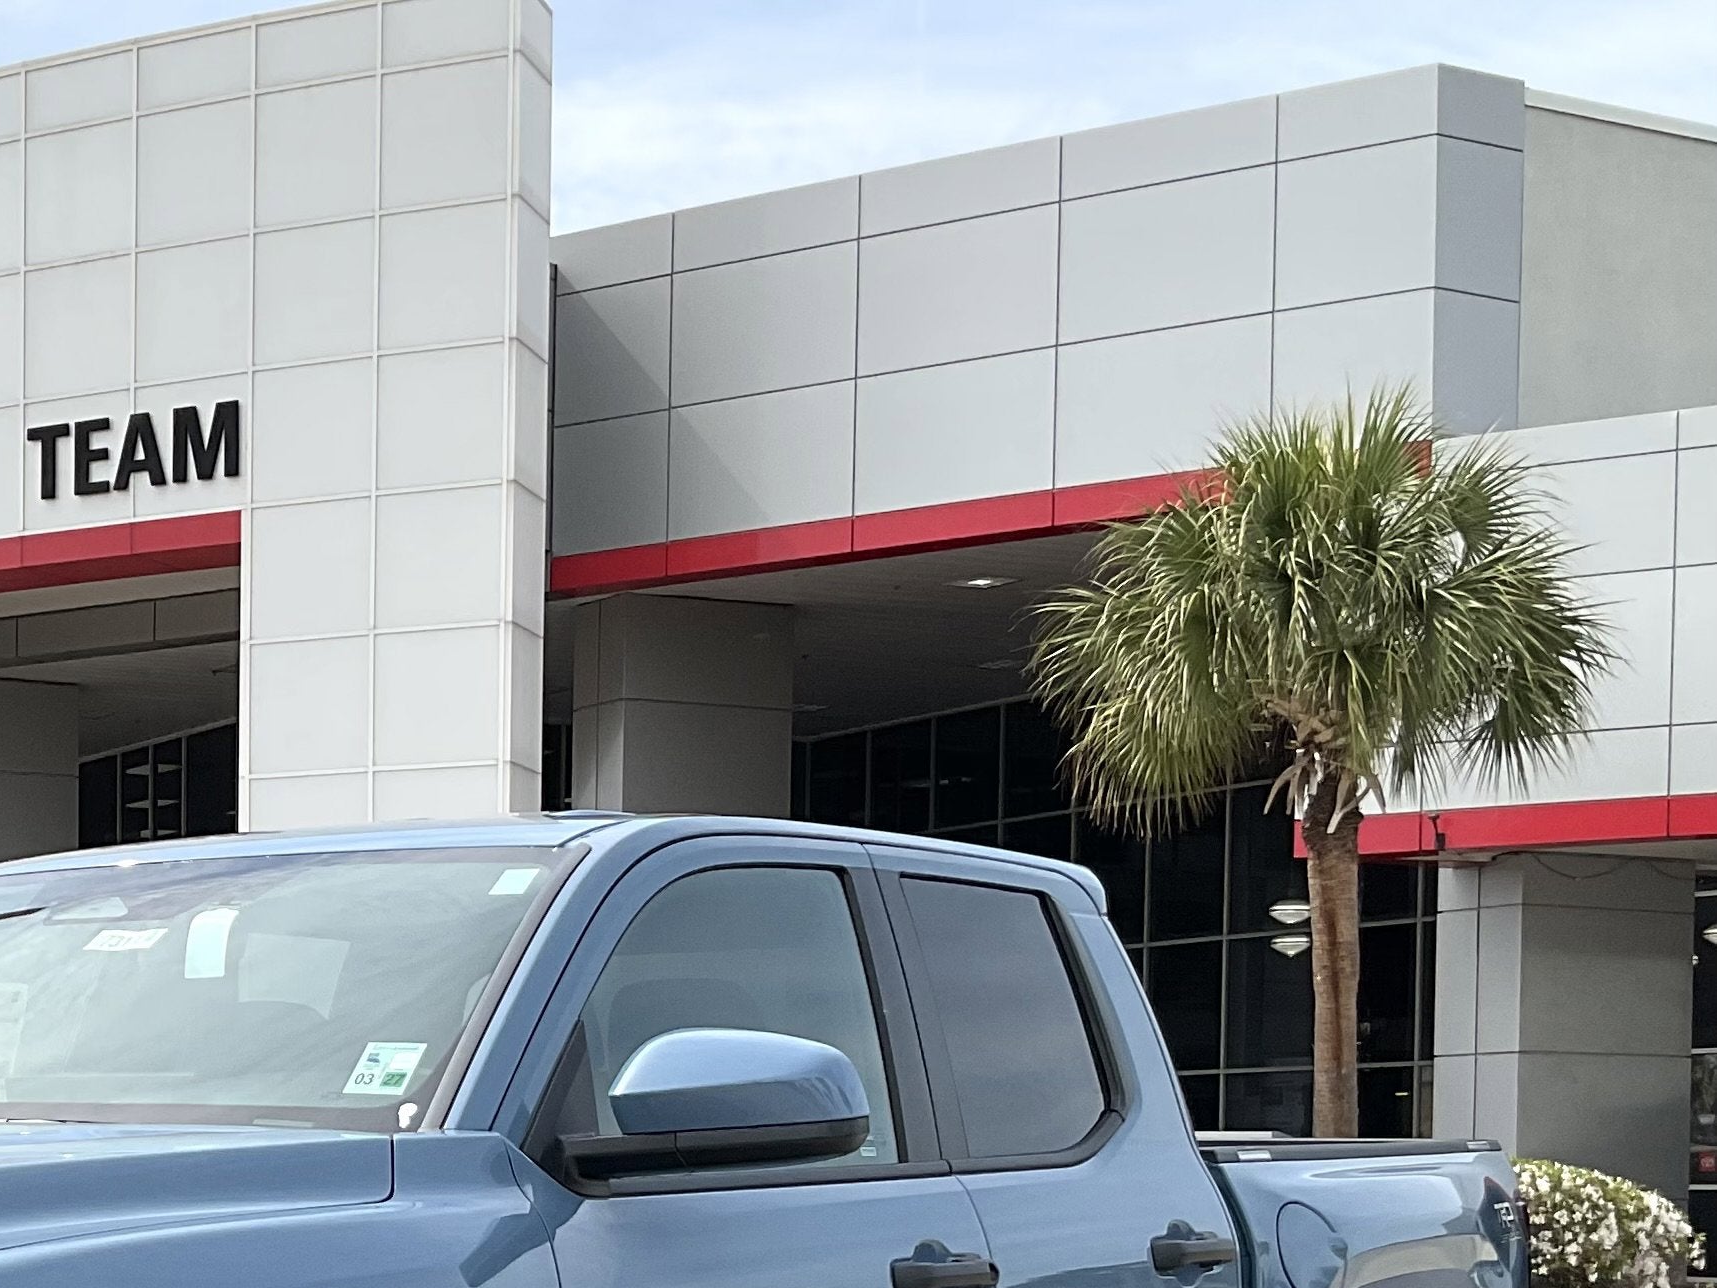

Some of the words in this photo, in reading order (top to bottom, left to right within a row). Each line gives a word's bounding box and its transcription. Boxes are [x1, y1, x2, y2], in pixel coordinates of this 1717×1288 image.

[27, 399, 240, 500] TEAM
[354, 1072, 375, 1085] 03
[383, 1073, 407, 1086] 27
